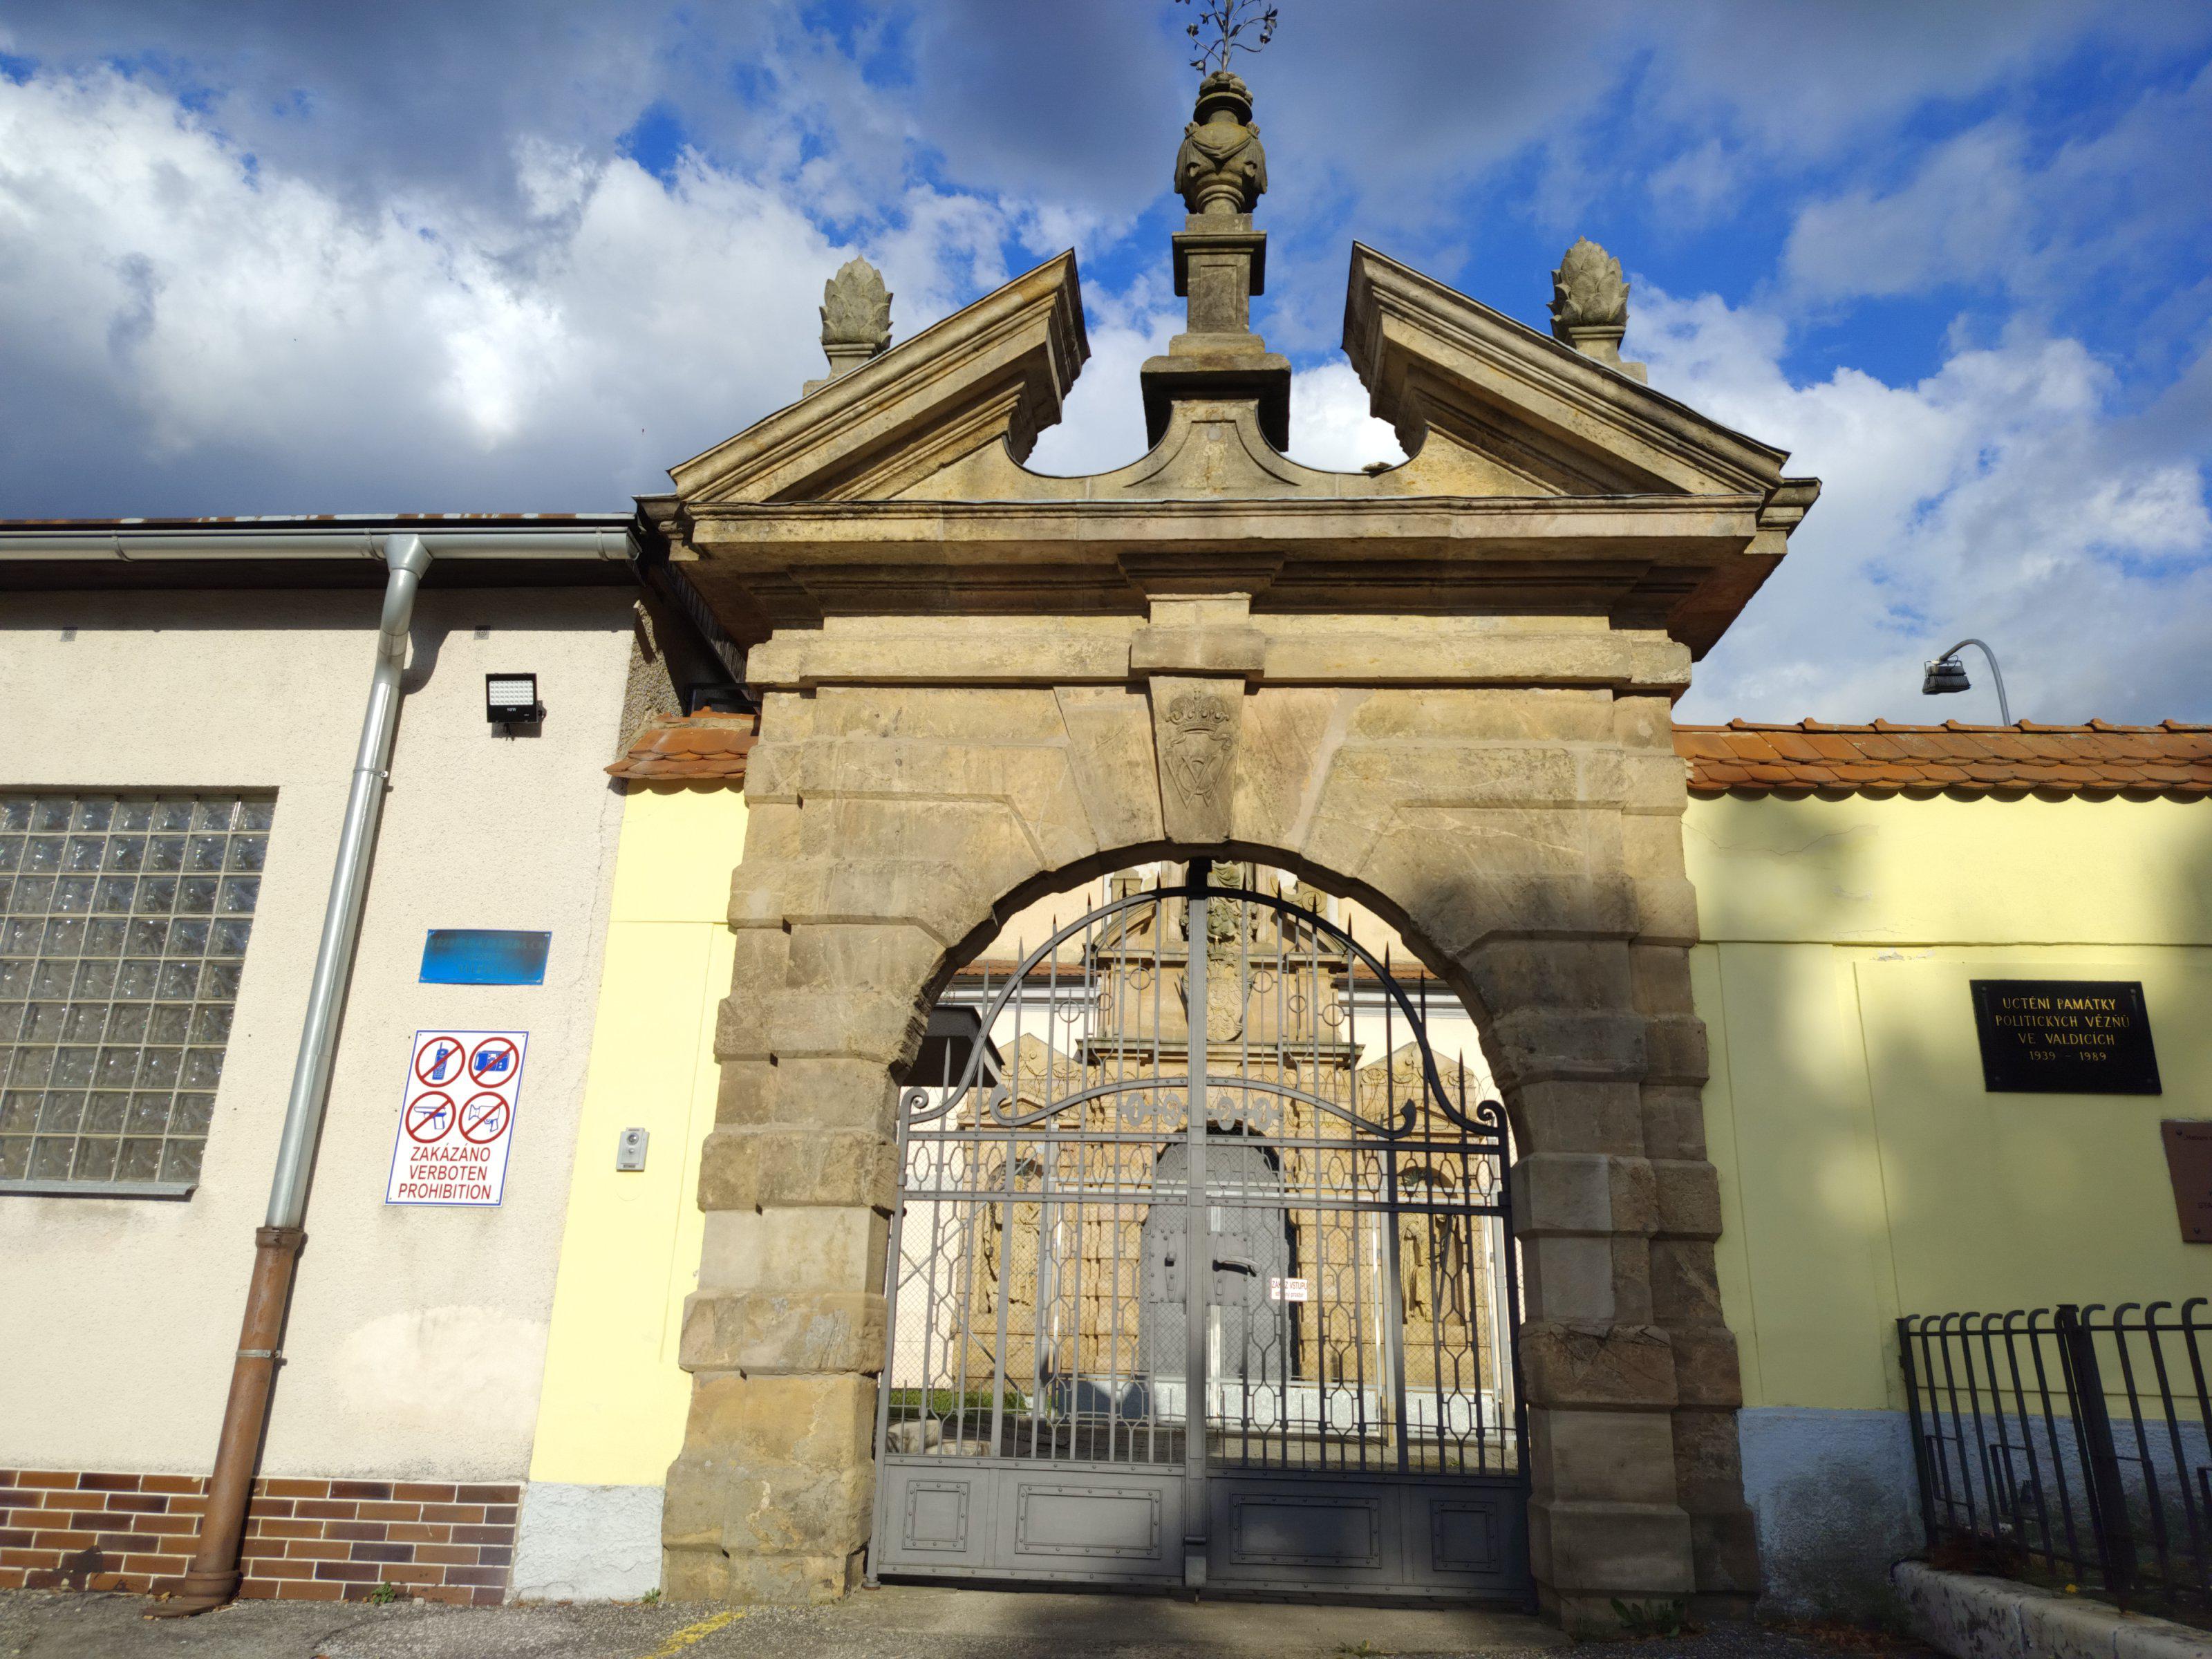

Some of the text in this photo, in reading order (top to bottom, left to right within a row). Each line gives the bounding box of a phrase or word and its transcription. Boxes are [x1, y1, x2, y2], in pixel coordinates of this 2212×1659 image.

[2057, 996, 2116, 1010] PAMÁTKY
[2018, 1031, 2115, 1045] VE VALDICÍCH
[2029, 1051, 2056, 1060] 1939
[2080, 1051, 2107, 1061] 1989
[410, 1143, 491, 1162] ZAKÁZÁNO
[409, 1165, 487, 1181] VERBOTEN
[397, 1183, 491, 1199] PROHIBITION
